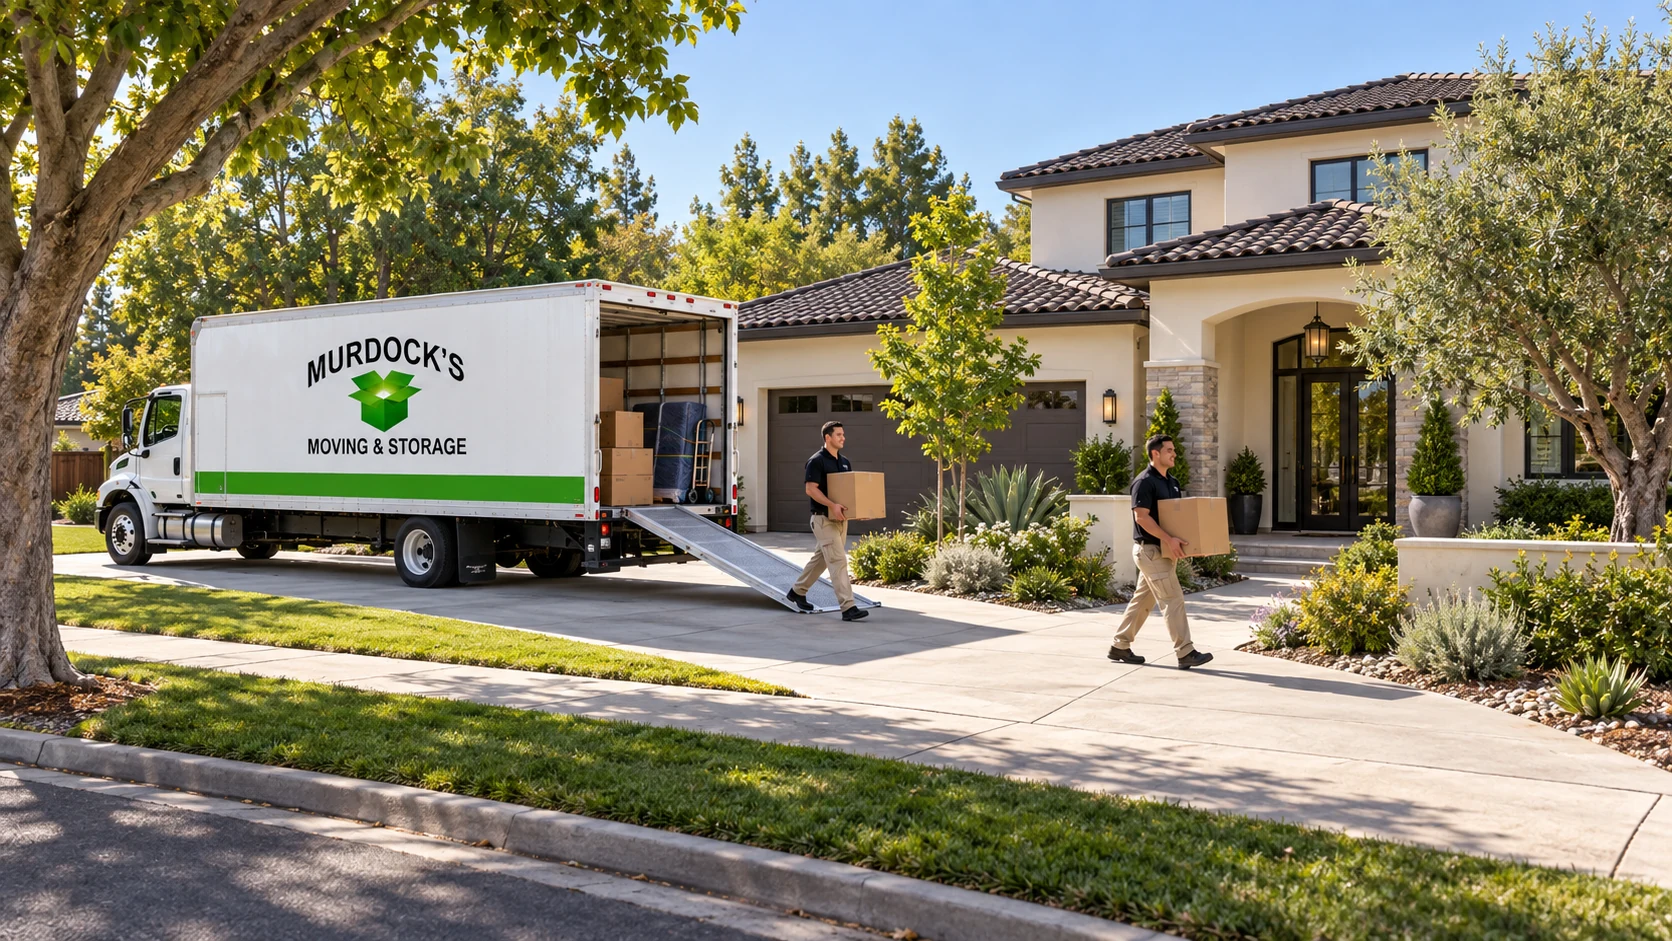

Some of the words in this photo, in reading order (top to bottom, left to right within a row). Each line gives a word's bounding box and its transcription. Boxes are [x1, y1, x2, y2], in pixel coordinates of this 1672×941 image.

[307, 336, 465, 388] MURDOCK'S
[307, 438, 368, 455] MOVING
[373, 438, 384, 455] &
[388, 437, 467, 455] STORAGE
